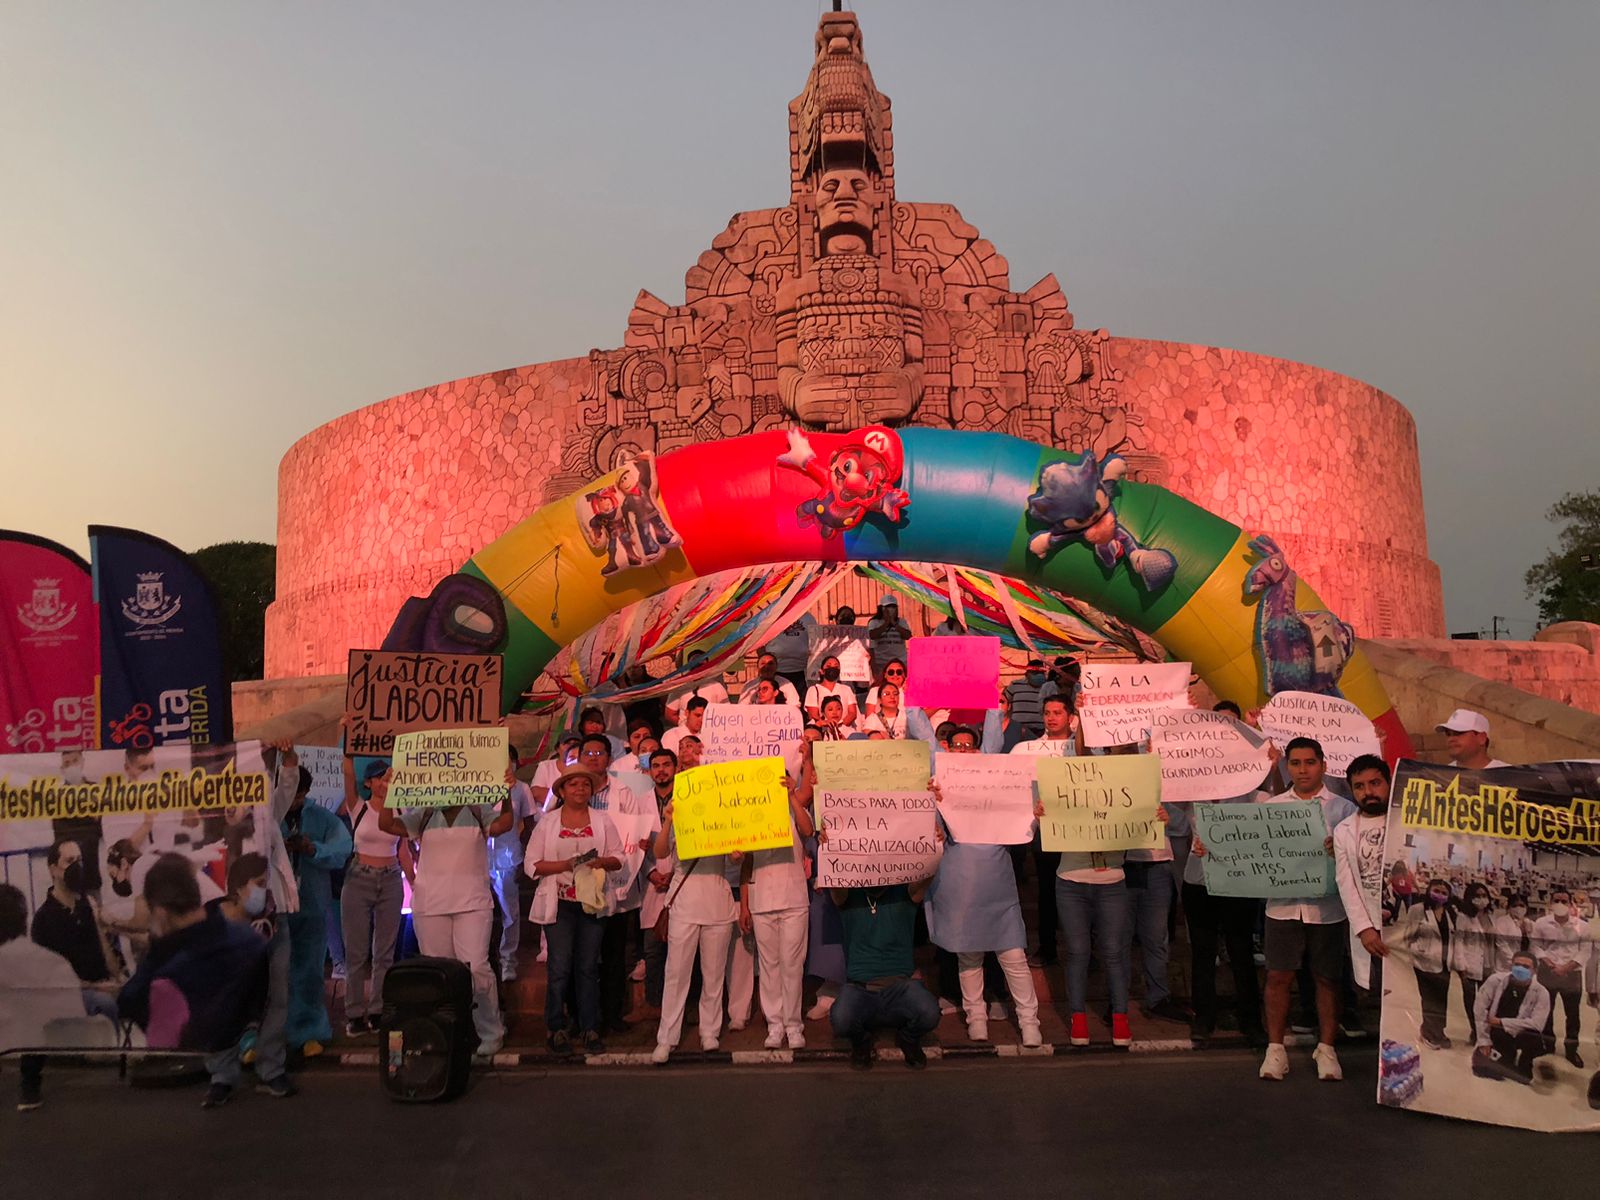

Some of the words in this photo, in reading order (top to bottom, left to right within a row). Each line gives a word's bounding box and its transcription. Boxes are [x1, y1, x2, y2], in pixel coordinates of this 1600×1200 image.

[351, 653, 483, 711] justicia
[1110, 677, 1120, 688] A
[1131, 675, 1151, 687] LA
[369, 684, 492, 723] LABORAL
[750, 710, 761, 725] el
[1152, 714, 1178, 727] LOS
[1280, 713, 1316, 728] TENER
[1322, 718, 1341, 728] UN
[711, 732, 719, 744] la
[754, 731, 763, 744] la
[767, 728, 803, 742] SALUD
[1164, 730, 1239, 742] ESTATALES
[748, 744, 780, 757] LUTO
[1158, 746, 1224, 759] EXIGIMOS
[1213, 762, 1264, 775] LABORAL
[393, 770, 433, 785] Ahora
[676, 769, 745, 800] Justicia
[394, 784, 509, 797] DESAMPARADOS
[719, 788, 772, 808] Laboral
[824, 793, 867, 808] BASES
[869, 797, 897, 810] PARA
[902, 797, 936, 810] TODOS
[1200, 807, 1247, 823] Pedimos
[1253, 807, 1263, 821] al
[1266, 807, 1312, 820] ESTADO
[847, 816, 858, 830] A
[866, 816, 888, 830] LA
[1208, 823, 1260, 844] Certeza
[1266, 822, 1312, 839] Laboral
[1207, 848, 1254, 866] Aceptar
[827, 858, 881, 873] YUCATAN
[884, 861, 924, 873] UNIDO
[1227, 869, 1246, 878] con
[1250, 862, 1286, 876] IMSS
[823, 875, 876, 887] PERSONAL
[1269, 871, 1322, 887] Bienestar
